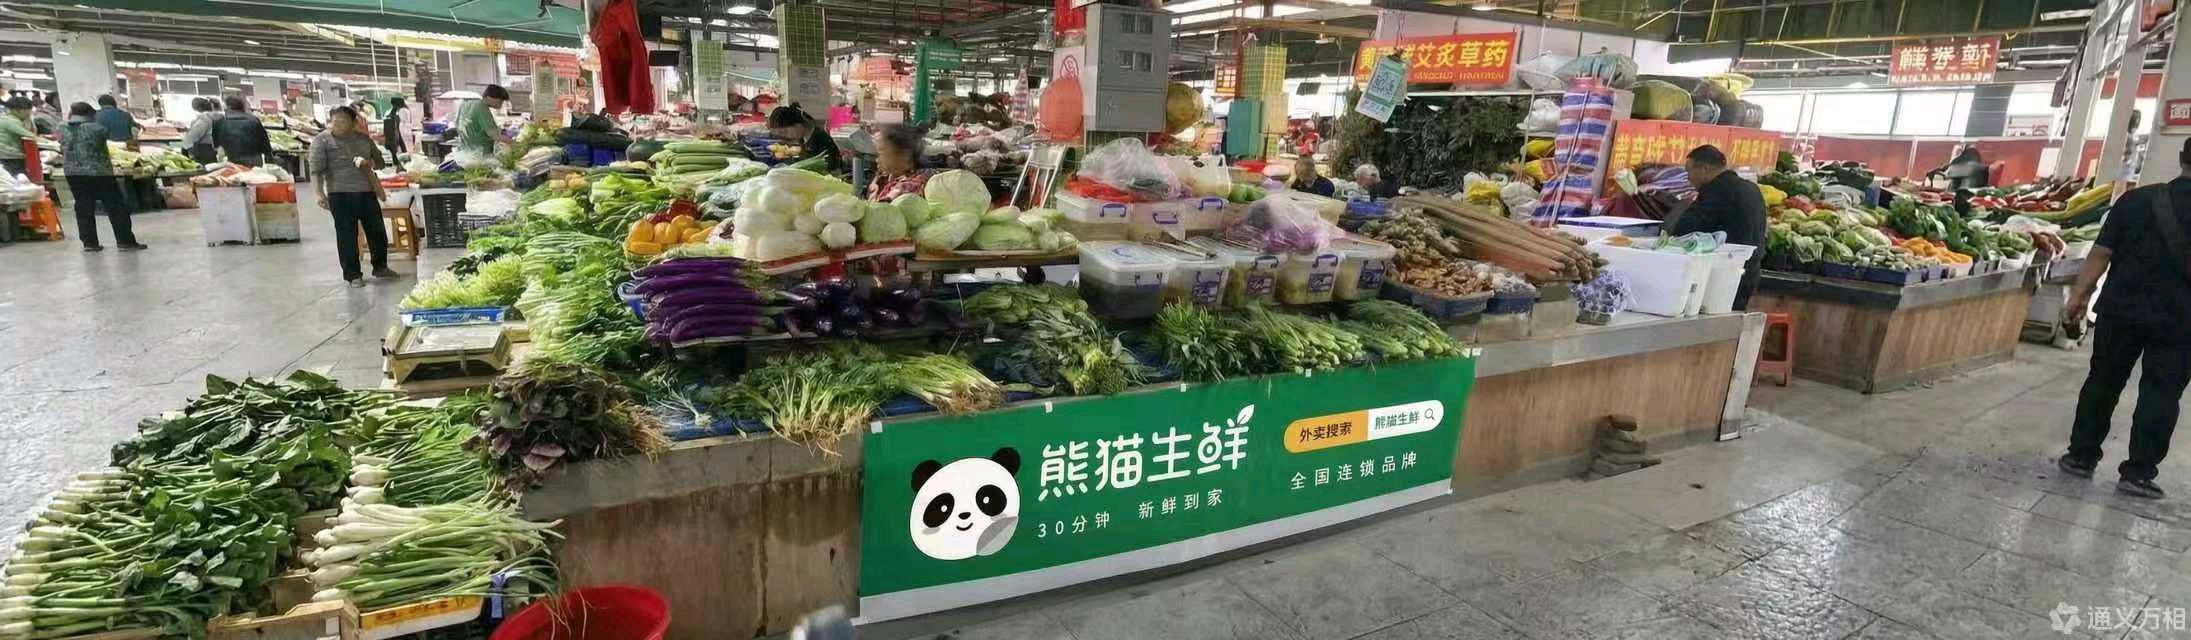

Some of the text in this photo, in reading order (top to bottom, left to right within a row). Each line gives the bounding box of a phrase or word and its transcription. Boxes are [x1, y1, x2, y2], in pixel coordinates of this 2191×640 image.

[1300, 421, 1353, 442] 外卖搜索
[1374, 411, 1420, 430] 熊猫生鲜
[1038, 405, 1254, 501] 熊猫生鲜
[1290, 451, 1417, 490] 全国连锁品牌
[1038, 489, 1223, 538] 30分钟 新鲜到家
